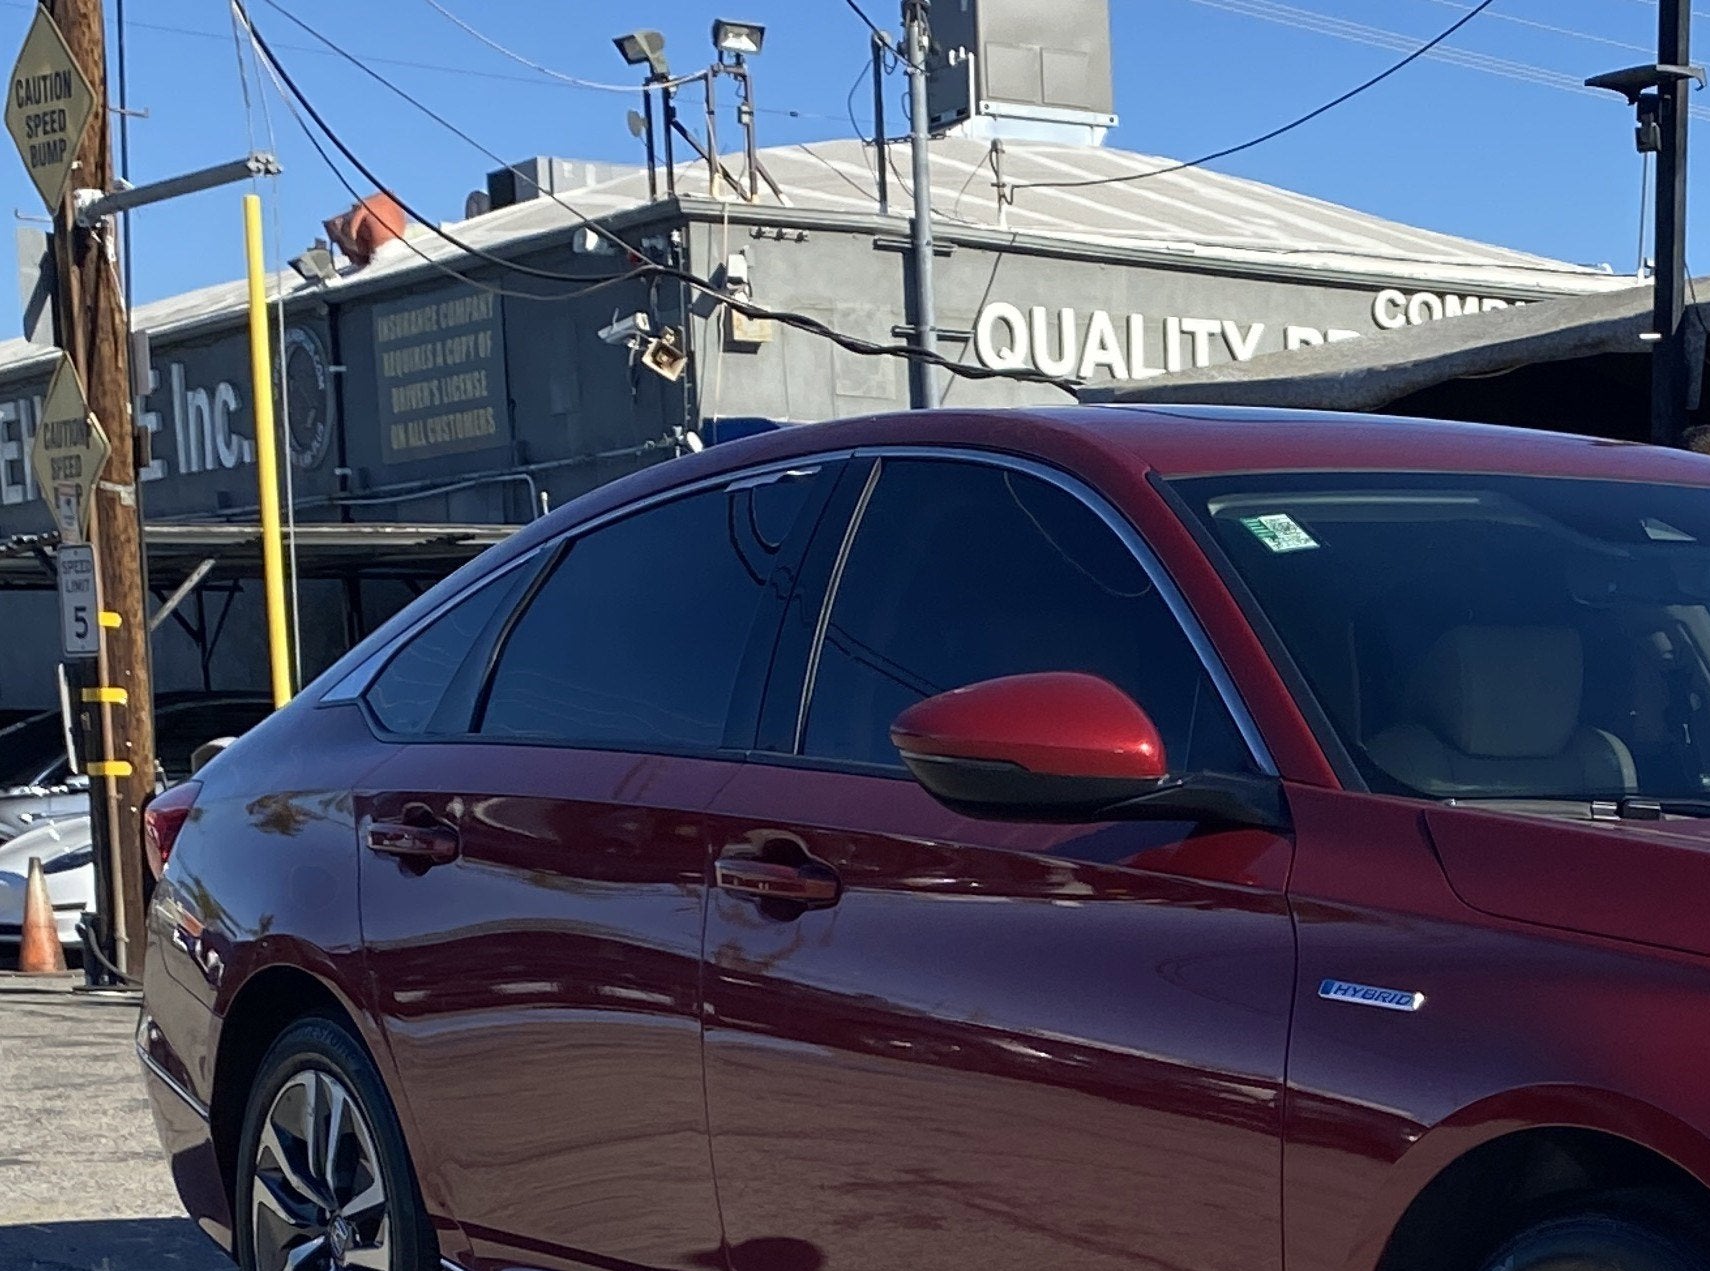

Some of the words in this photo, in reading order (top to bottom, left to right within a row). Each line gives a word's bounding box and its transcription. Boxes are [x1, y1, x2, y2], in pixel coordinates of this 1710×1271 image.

[15, 70, 72, 109] CAUTION
[25, 109, 67, 139] SPEED
[30, 139, 67, 168] BUMP
[439, 292, 494, 329] COMPANY
[445, 334, 475, 365] COPY
[975, 302, 1265, 379] QUALITY
[441, 370, 488, 404] LICENSE
[43, 417, 92, 451] CAUTION
[170, 362, 255, 474] Inc.
[427, 406, 496, 444] CUSTOMERS
[51, 454, 82, 481] SPEED
[62, 560, 92, 575] SPEED
[65, 579, 90, 594] LIMIT
[74, 605, 89, 640] 5
[1333, 983, 1412, 1006] HYBRID
